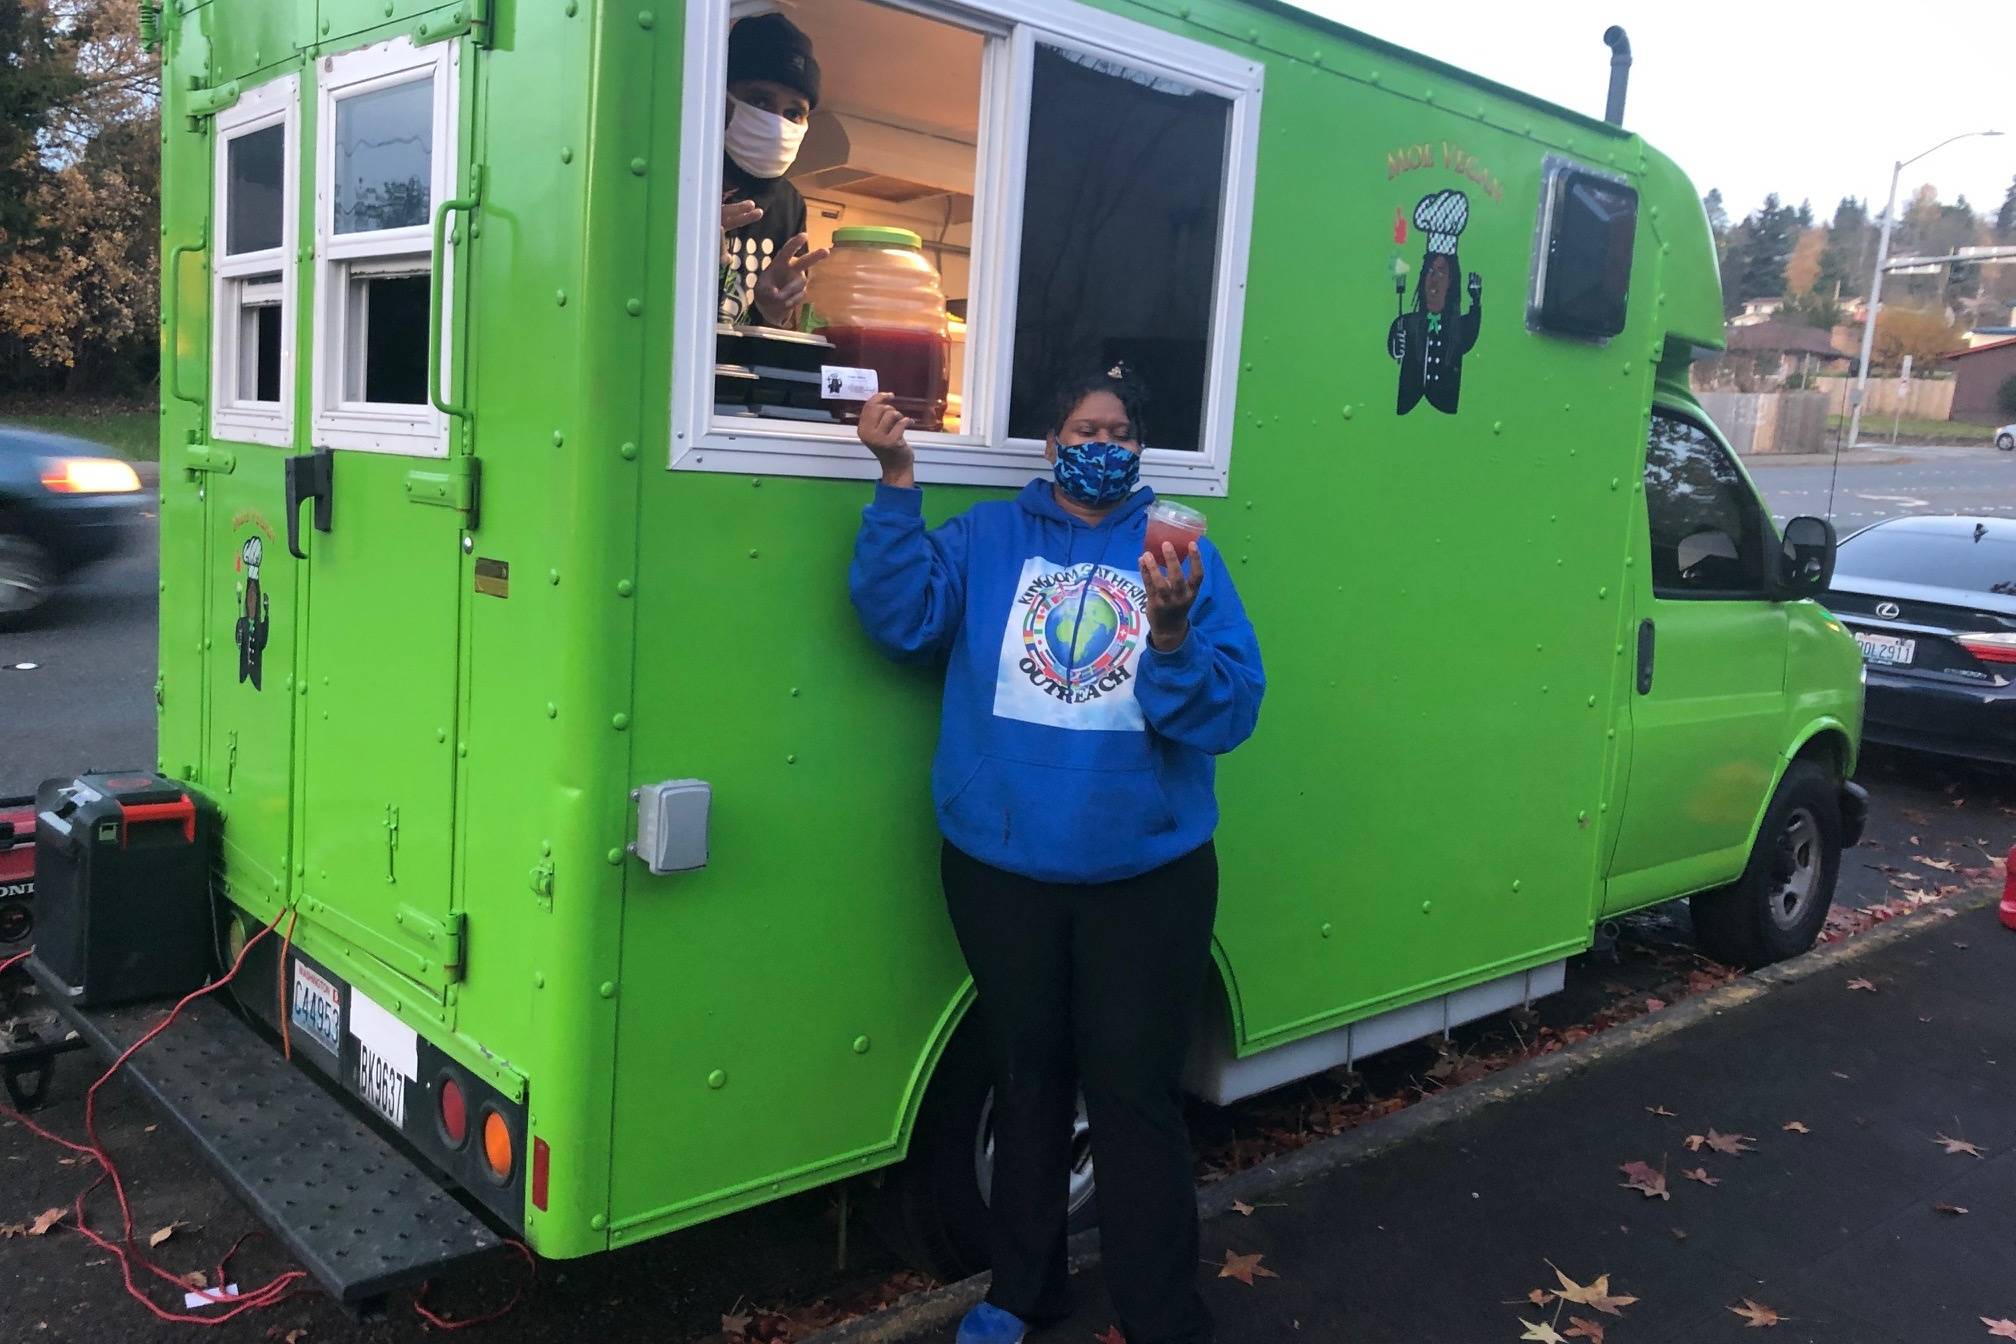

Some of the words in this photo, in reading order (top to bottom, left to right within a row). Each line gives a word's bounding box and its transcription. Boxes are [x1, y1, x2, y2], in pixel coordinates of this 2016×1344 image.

[1018, 568, 1078, 605] KINGDOM
[1019, 657, 1131, 704] OUTREACH
[294, 980, 339, 1044] C44953
[361, 1045, 403, 1122] BK9637
